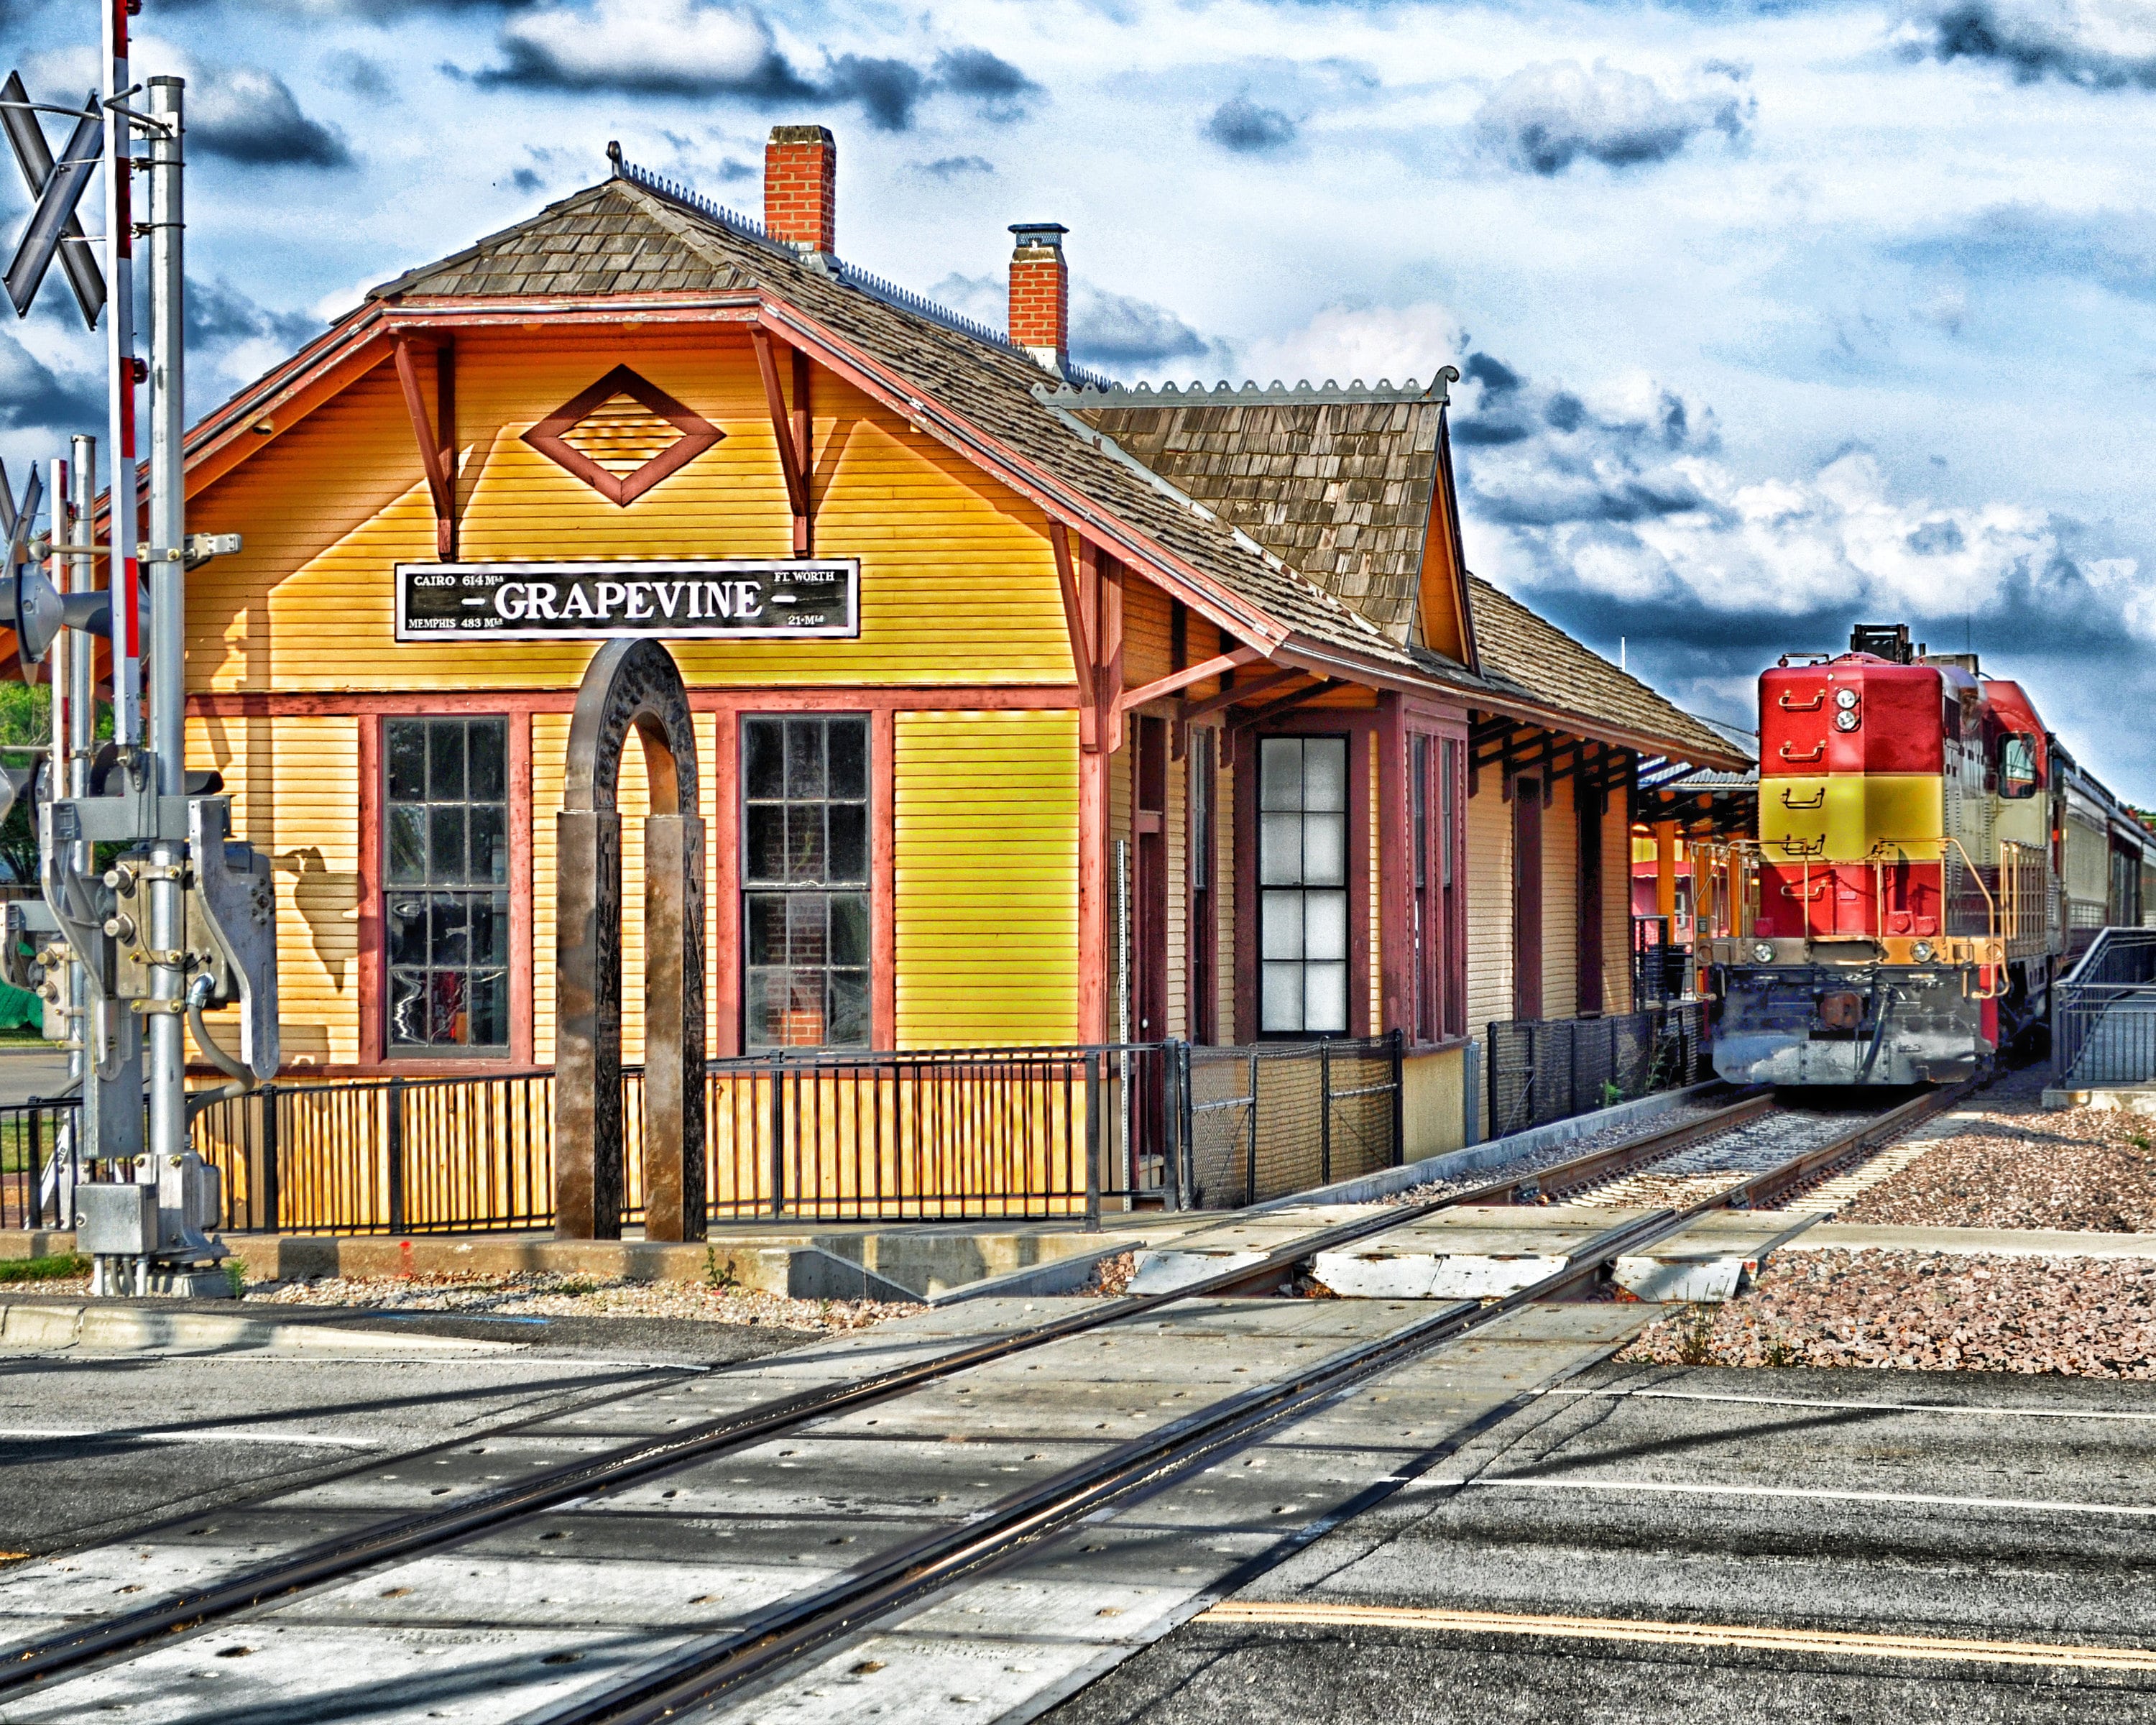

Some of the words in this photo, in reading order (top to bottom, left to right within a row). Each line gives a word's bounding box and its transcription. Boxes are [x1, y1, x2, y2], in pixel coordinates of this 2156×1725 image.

[414, 576, 456, 586] CAIRO
[462, 575, 483, 586] 614
[773, 571, 791, 581] FT.
[792, 571, 835, 581] WORTH
[494, 581, 763, 620] GRAPEVINE
[407, 618, 456, 629] MEMPHIS
[461, 618, 481, 628] 483
